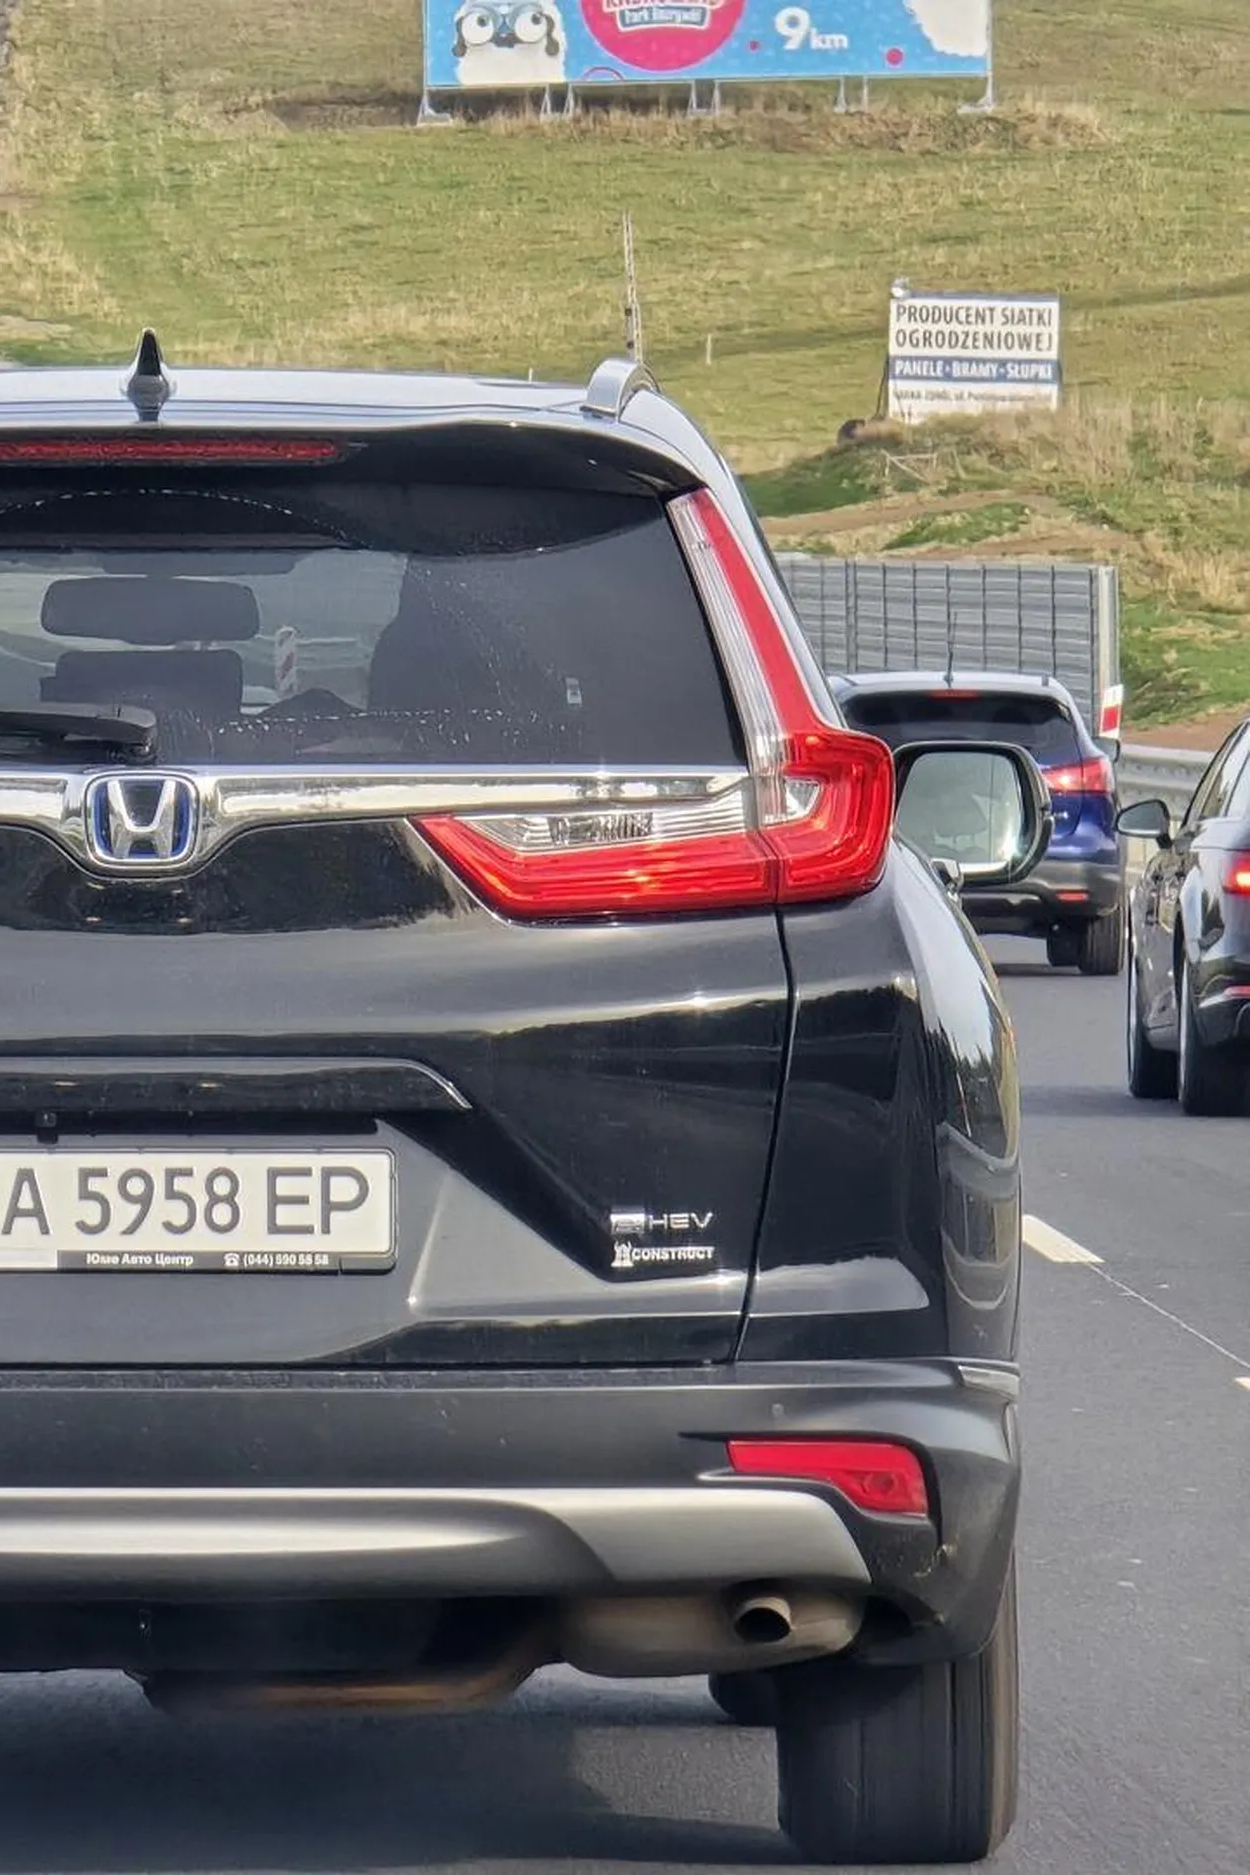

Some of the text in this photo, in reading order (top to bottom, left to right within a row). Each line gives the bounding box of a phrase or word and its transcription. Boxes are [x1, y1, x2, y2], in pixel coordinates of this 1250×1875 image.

[775, 7, 848, 49] 9 km
[896, 305, 1052, 327] PRODUCENT SIATKI
[895, 328, 1052, 351] OGRODZENIOWEJ
[894, 360, 944, 377] PANELE
[952, 362, 998, 378] BRAMY
[75, 1167, 240, 1236] 5958
[267, 1166, 369, 1236] EP
[649, 1212, 713, 1230] HEV
[121, 1253, 153, 1264] Авто
[155, 1253, 194, 1266] Центр
[243, 1253, 274, 1267] (044)
[631, 1246, 715, 1260] CONSTRUCT
